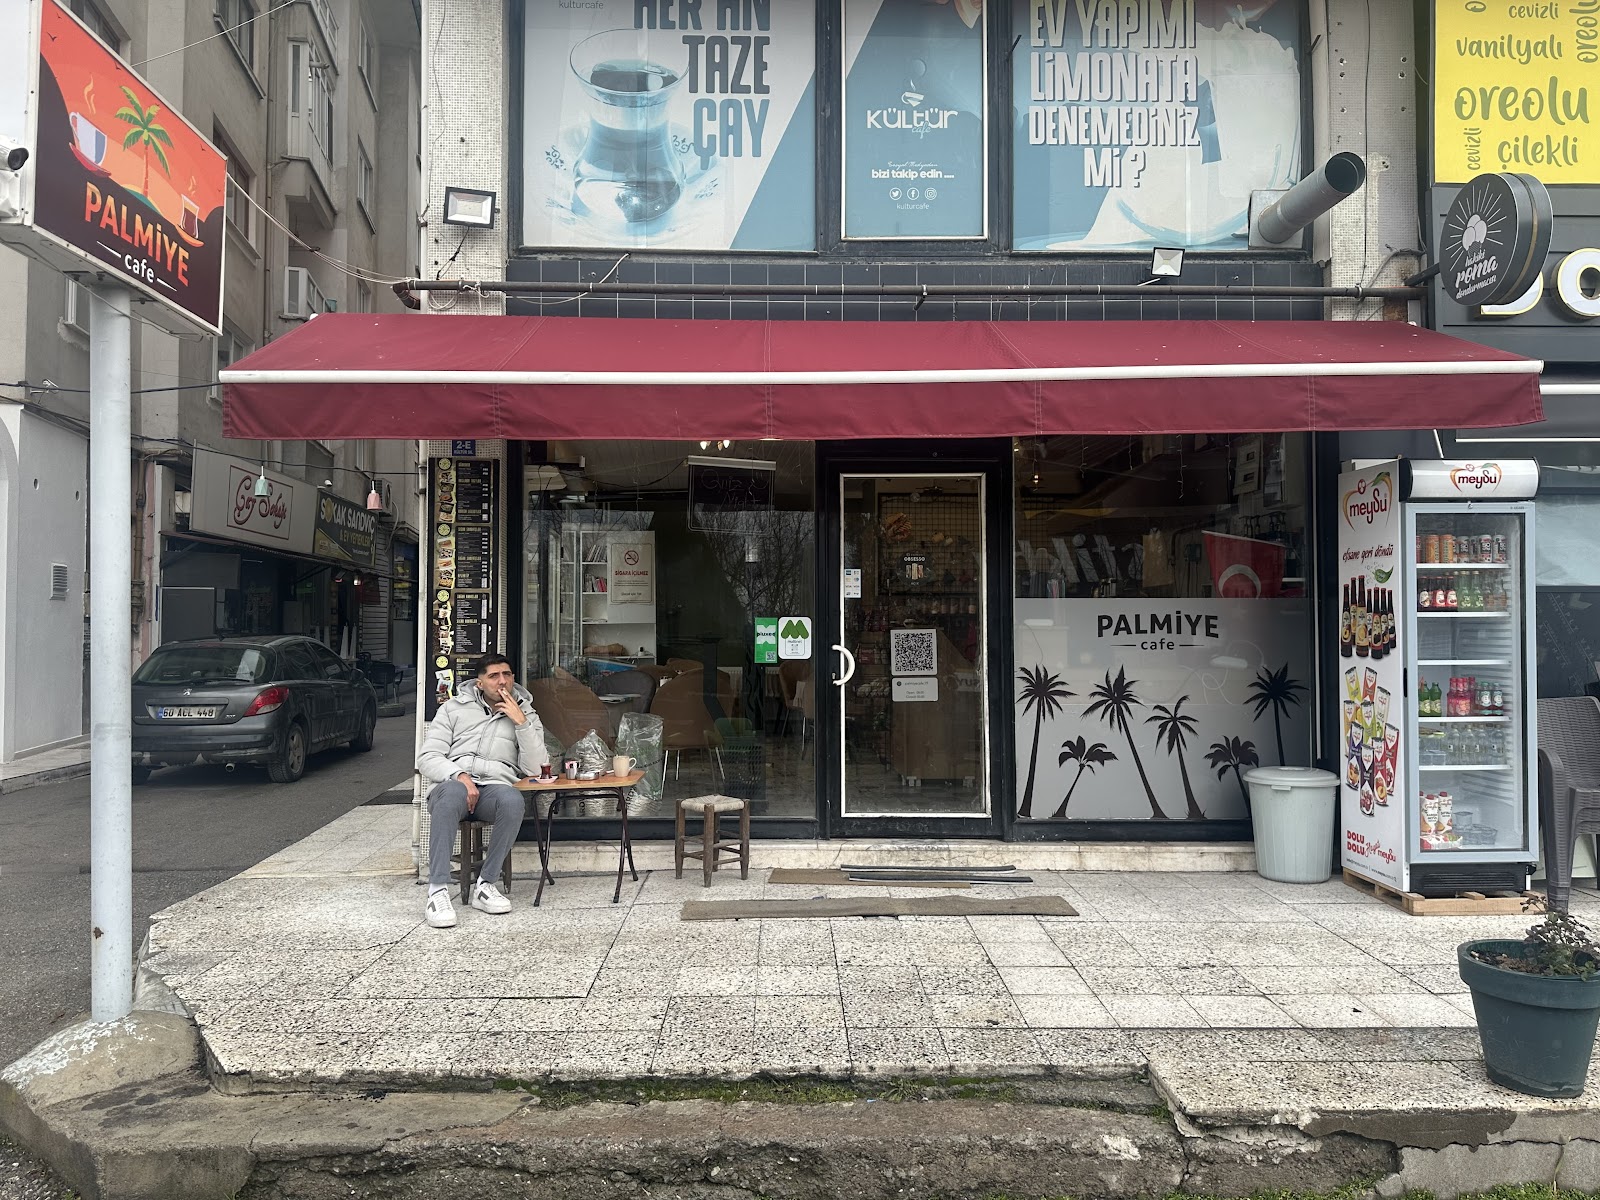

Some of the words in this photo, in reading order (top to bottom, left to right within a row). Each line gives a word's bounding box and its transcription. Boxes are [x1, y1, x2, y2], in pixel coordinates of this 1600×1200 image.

[559, 0, 604, 9] kulturcafe
[1508, 2, 1559, 19] cevizli
[1029, 0, 1068, 47] EV
[1074, 0, 1197, 48] YAPIMI
[682, 35, 770, 94] TAZE
[1456, 34, 1563, 65] vanilyalı
[1030, 52, 1199, 102] LİMONATA
[1454, 76, 1590, 126] oreolu
[693, 98, 771, 171] ÇAY
[911, 122, 931, 139] cafe
[1028, 105, 1201, 147] DENEMEDİNİZ
[1463, 127, 1481, 170] cevizli
[1498, 134, 1578, 170] çilekli
[871, 169, 890, 178] bizi
[891, 169, 918, 180] takip
[920, 169, 943, 178] edin
[84, 181, 190, 287] PALMİYE
[124, 249, 155, 284] cafe
[456, 441, 471, 449] 2-E
[1342, 547, 1360, 563] efsane
[1361, 547, 1374, 564] geri
[1374, 543, 1394, 558] döndü
[1097, 610, 1219, 639] PALMİYE
[1141, 638, 1175, 650] cafe
[163, 708, 174, 717] 60
[197, 708, 214, 717] 448
[1347, 830, 1365, 844] DOLU
[1347, 841, 1365, 856] DOLU
